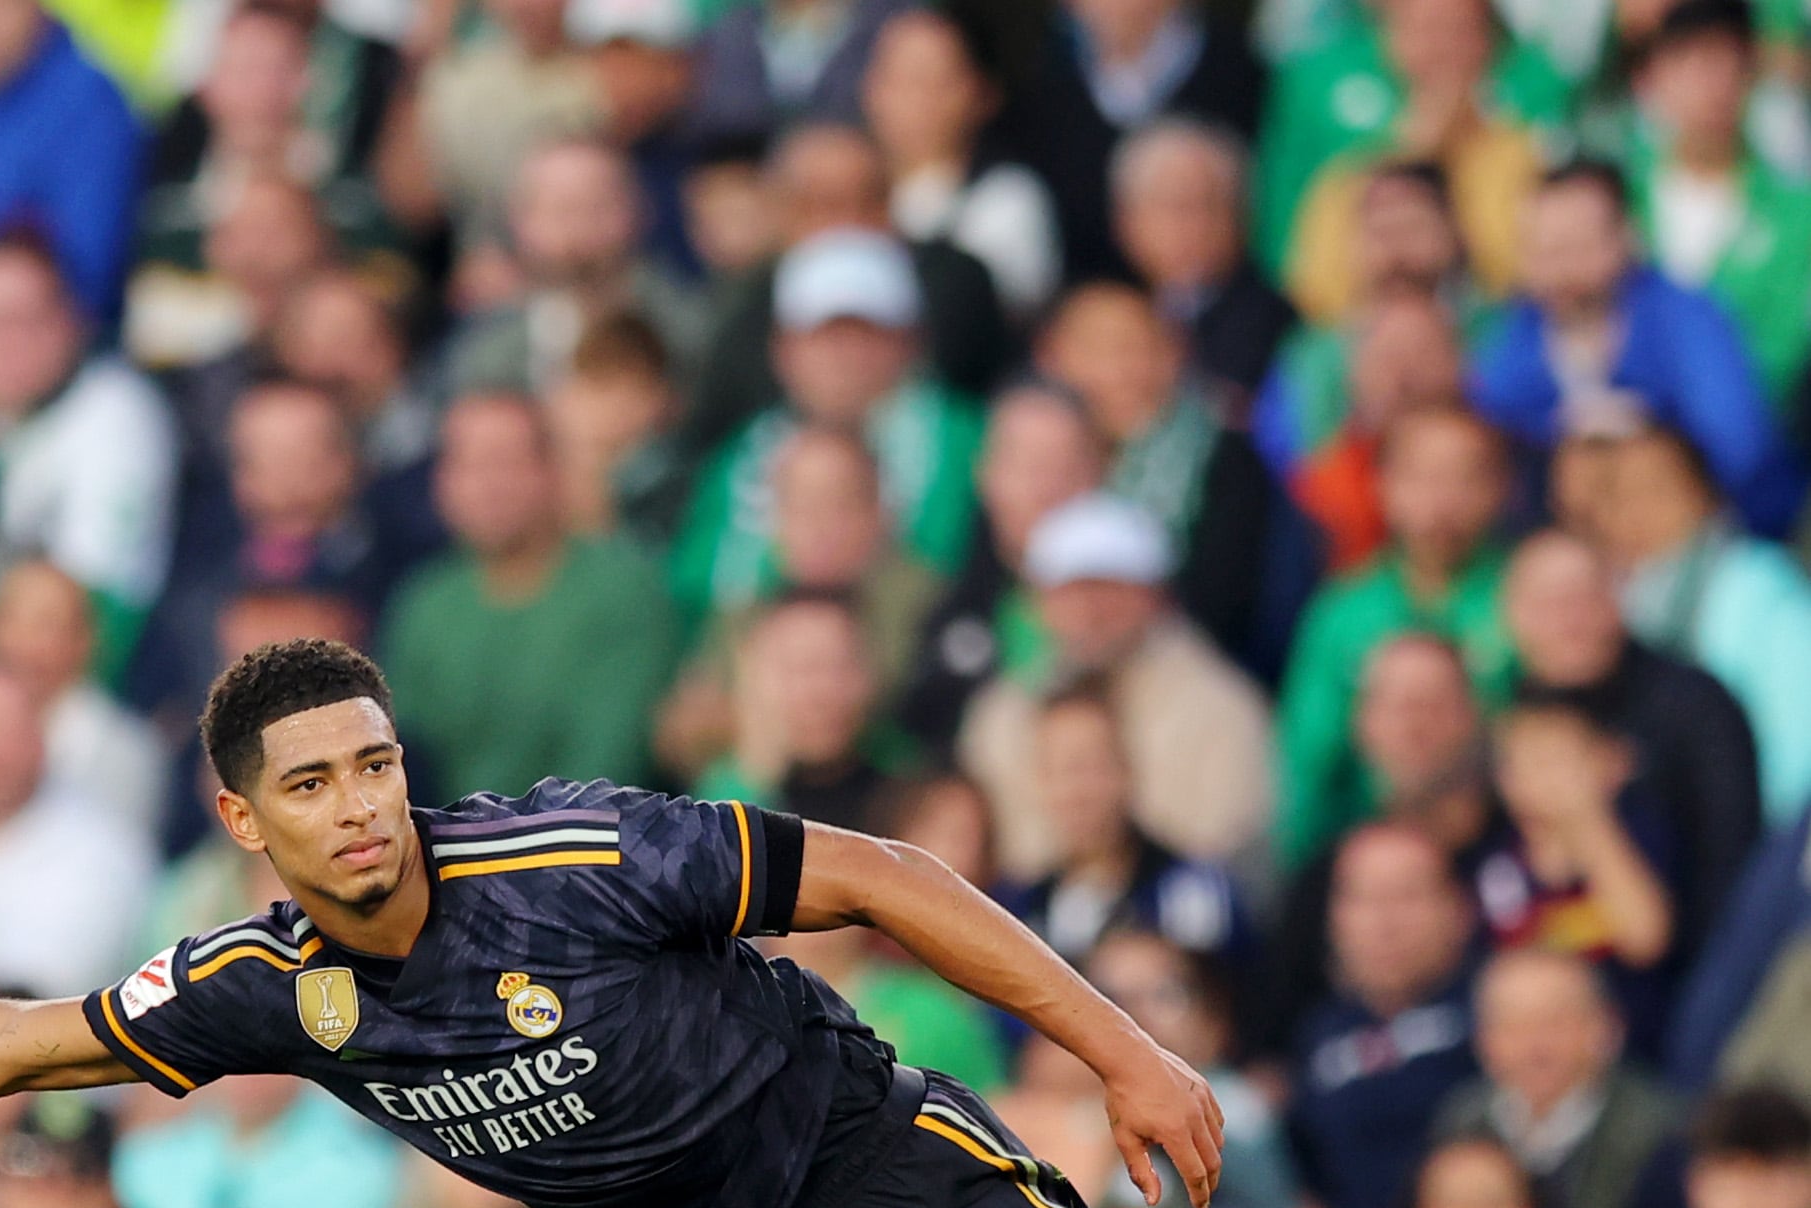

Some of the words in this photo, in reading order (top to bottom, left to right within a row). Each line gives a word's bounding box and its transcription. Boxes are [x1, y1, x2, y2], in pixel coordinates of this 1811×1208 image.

[317, 1018, 343, 1031] FIFA
[364, 1036, 598, 1121] Emirates
[433, 1123, 486, 1157] FLY
[482, 1092, 596, 1154] BETTER
